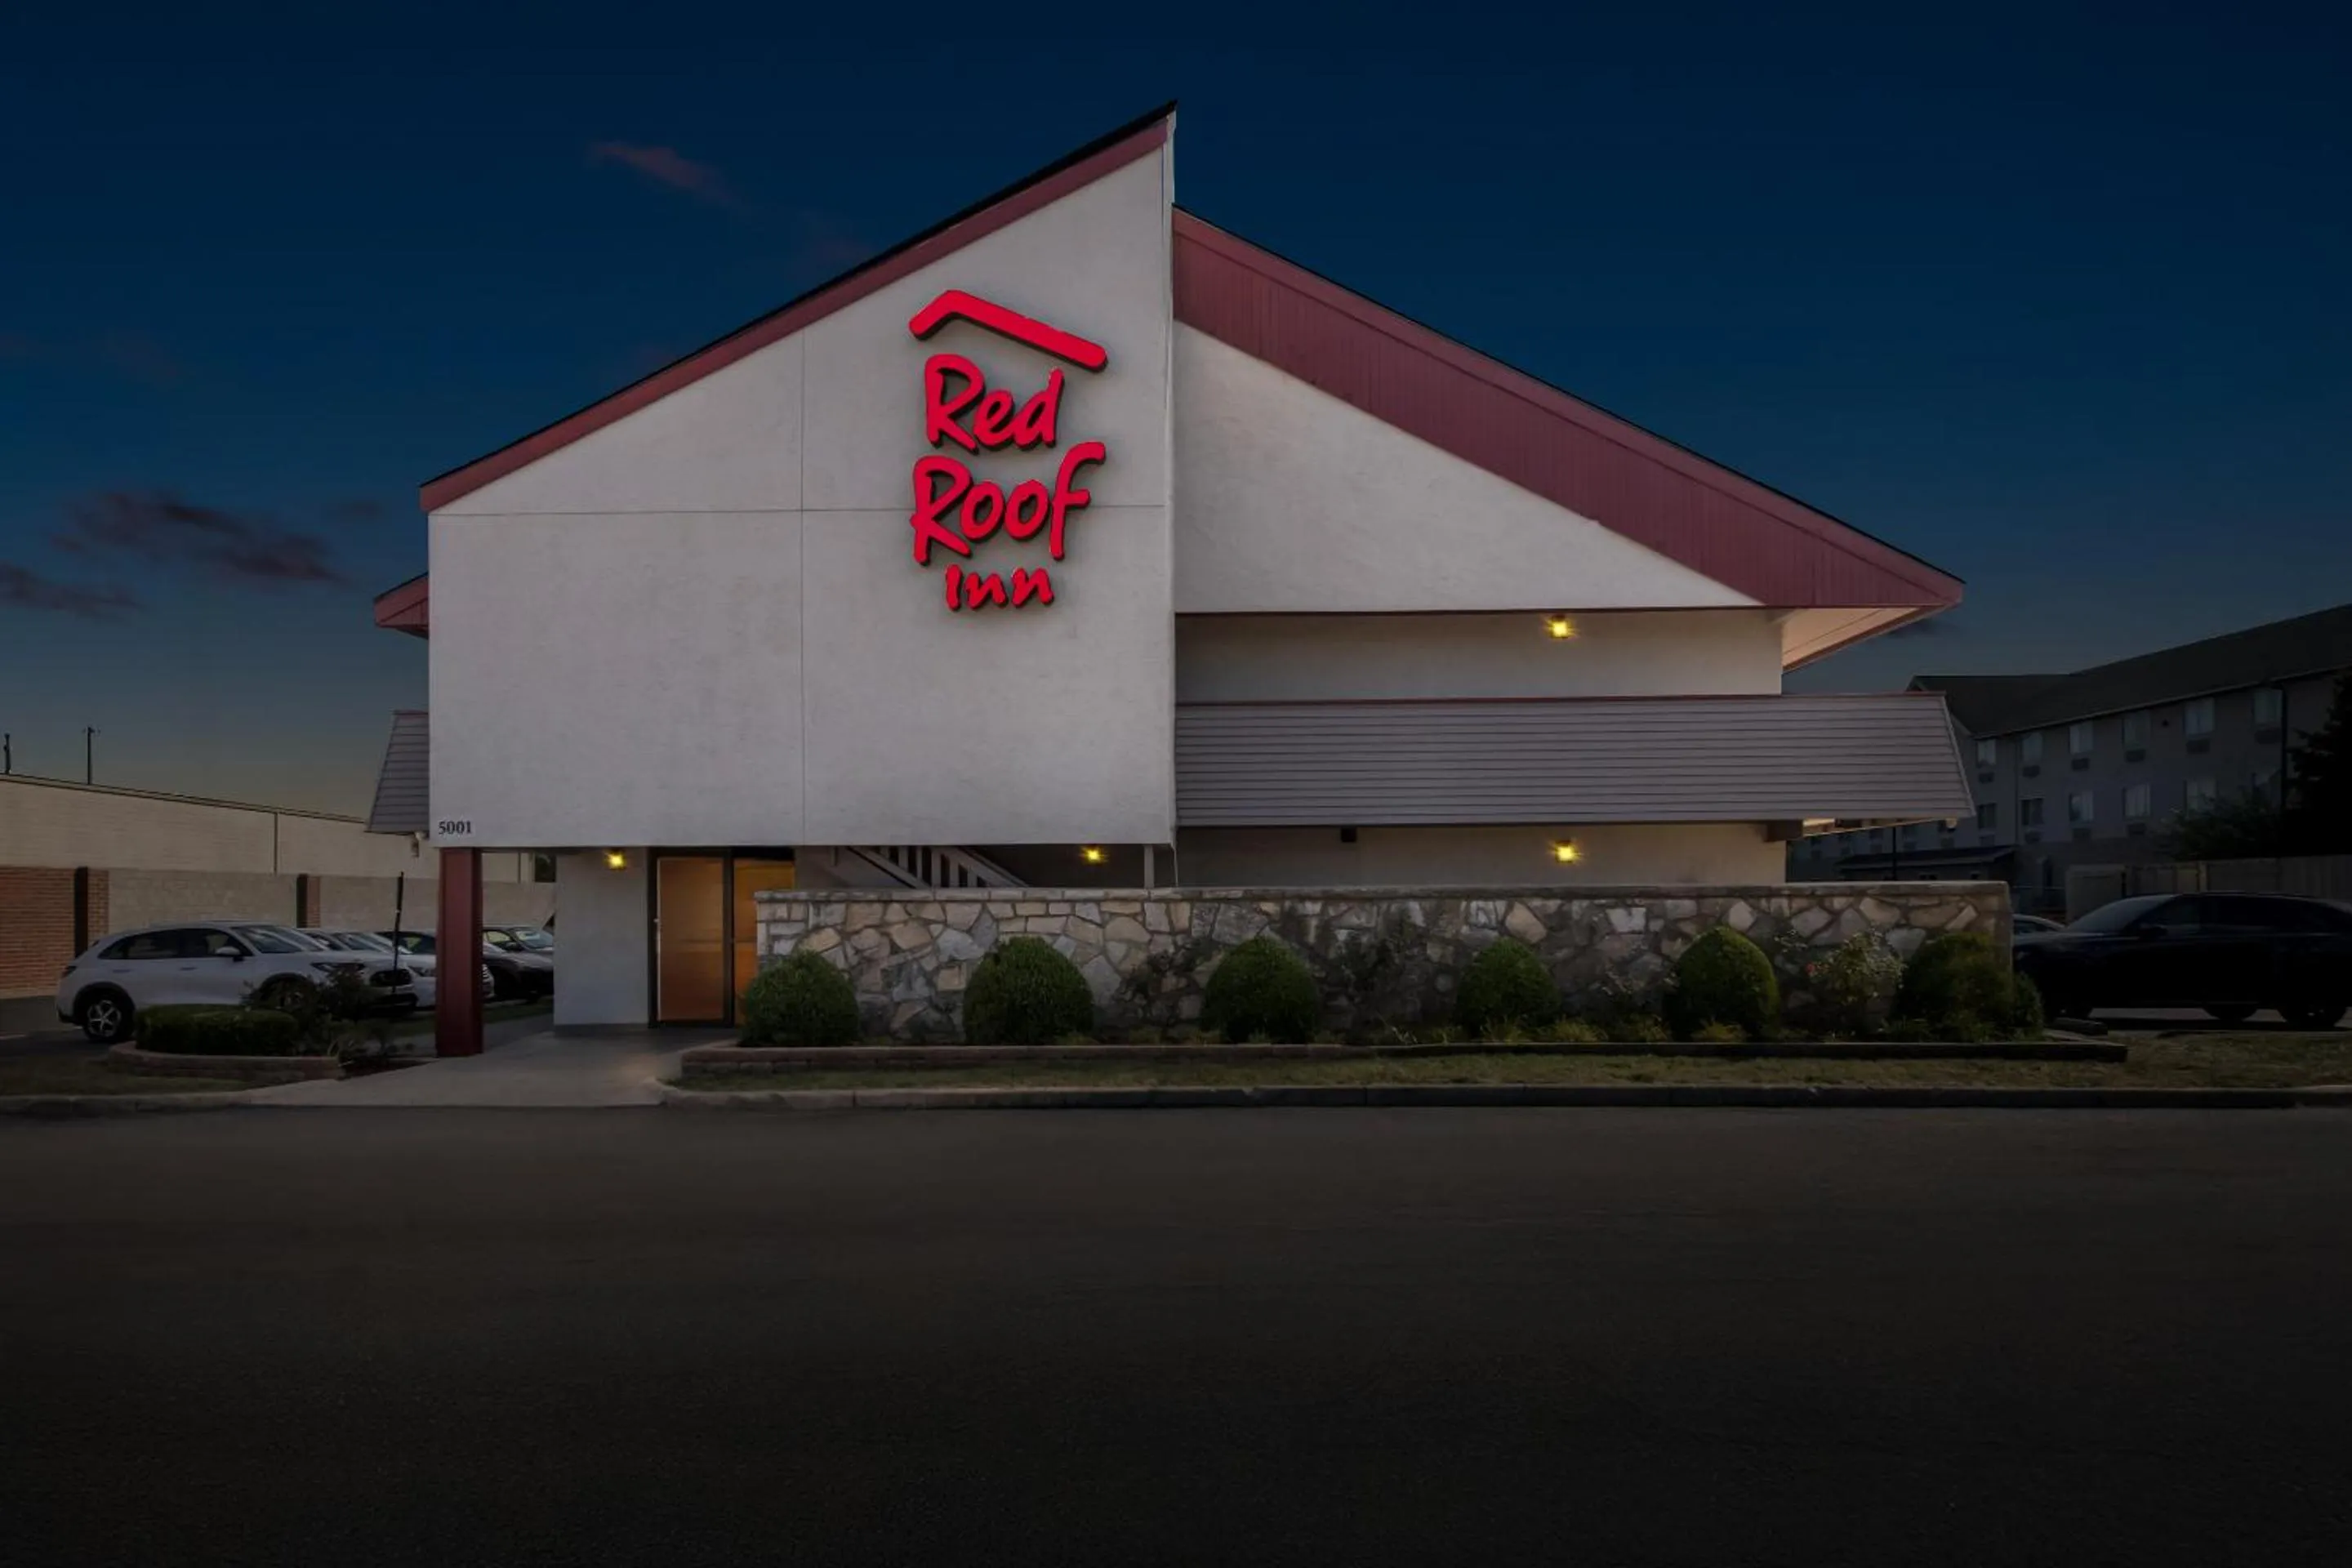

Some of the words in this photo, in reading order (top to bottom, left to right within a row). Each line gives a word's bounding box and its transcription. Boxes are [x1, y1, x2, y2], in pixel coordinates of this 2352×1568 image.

[924, 353, 1063, 452] Red
[910, 441, 1106, 563] Roof
[438, 820, 472, 835] 5001
